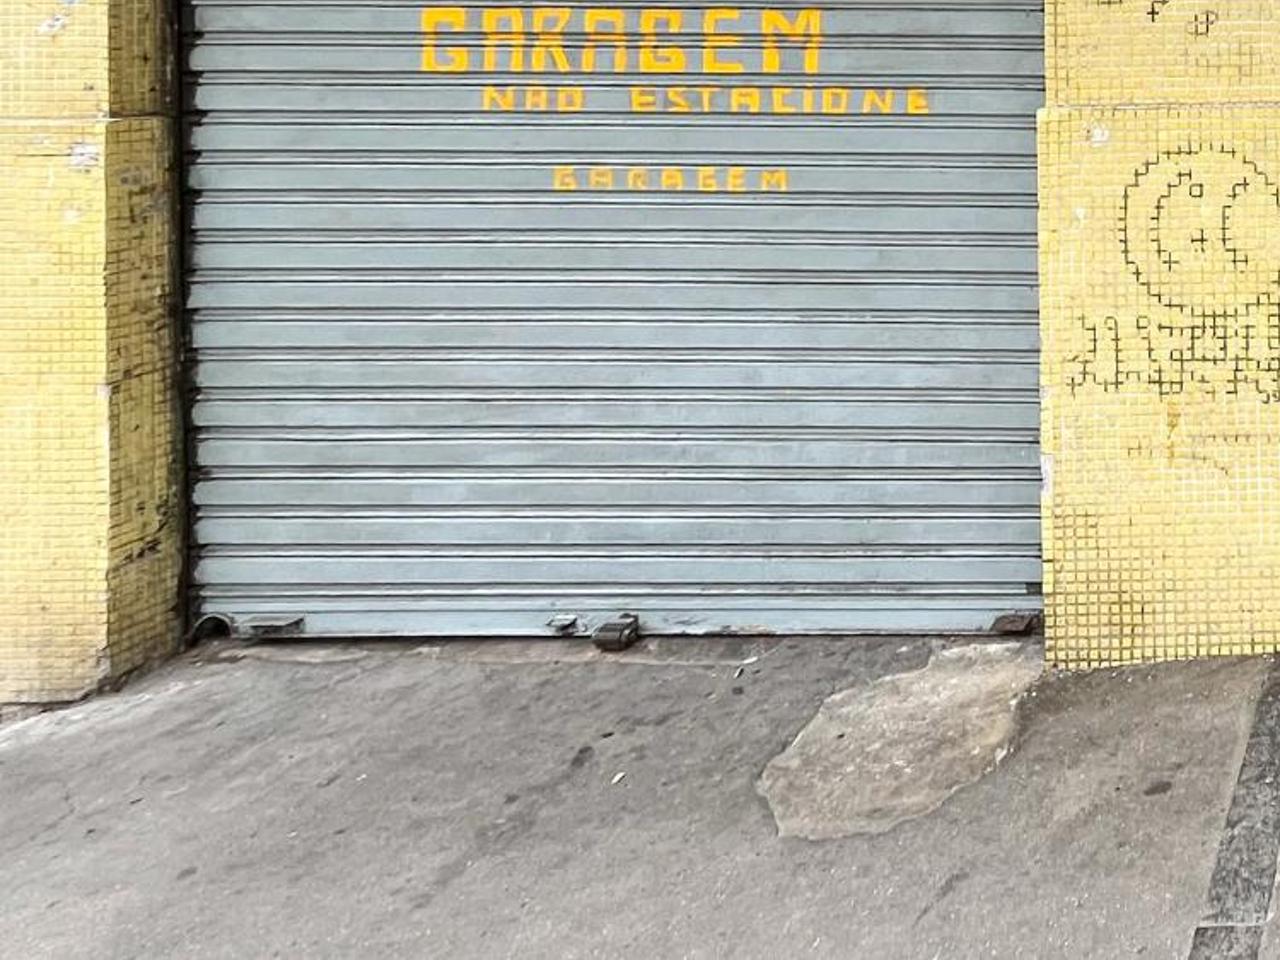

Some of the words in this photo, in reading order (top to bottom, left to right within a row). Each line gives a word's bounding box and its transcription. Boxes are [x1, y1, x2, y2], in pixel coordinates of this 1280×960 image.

[420, 6, 823, 74] GARAGEM
[631, 85, 930, 115] ESTACIONE
[553, 165, 789, 193] GARAGEM
